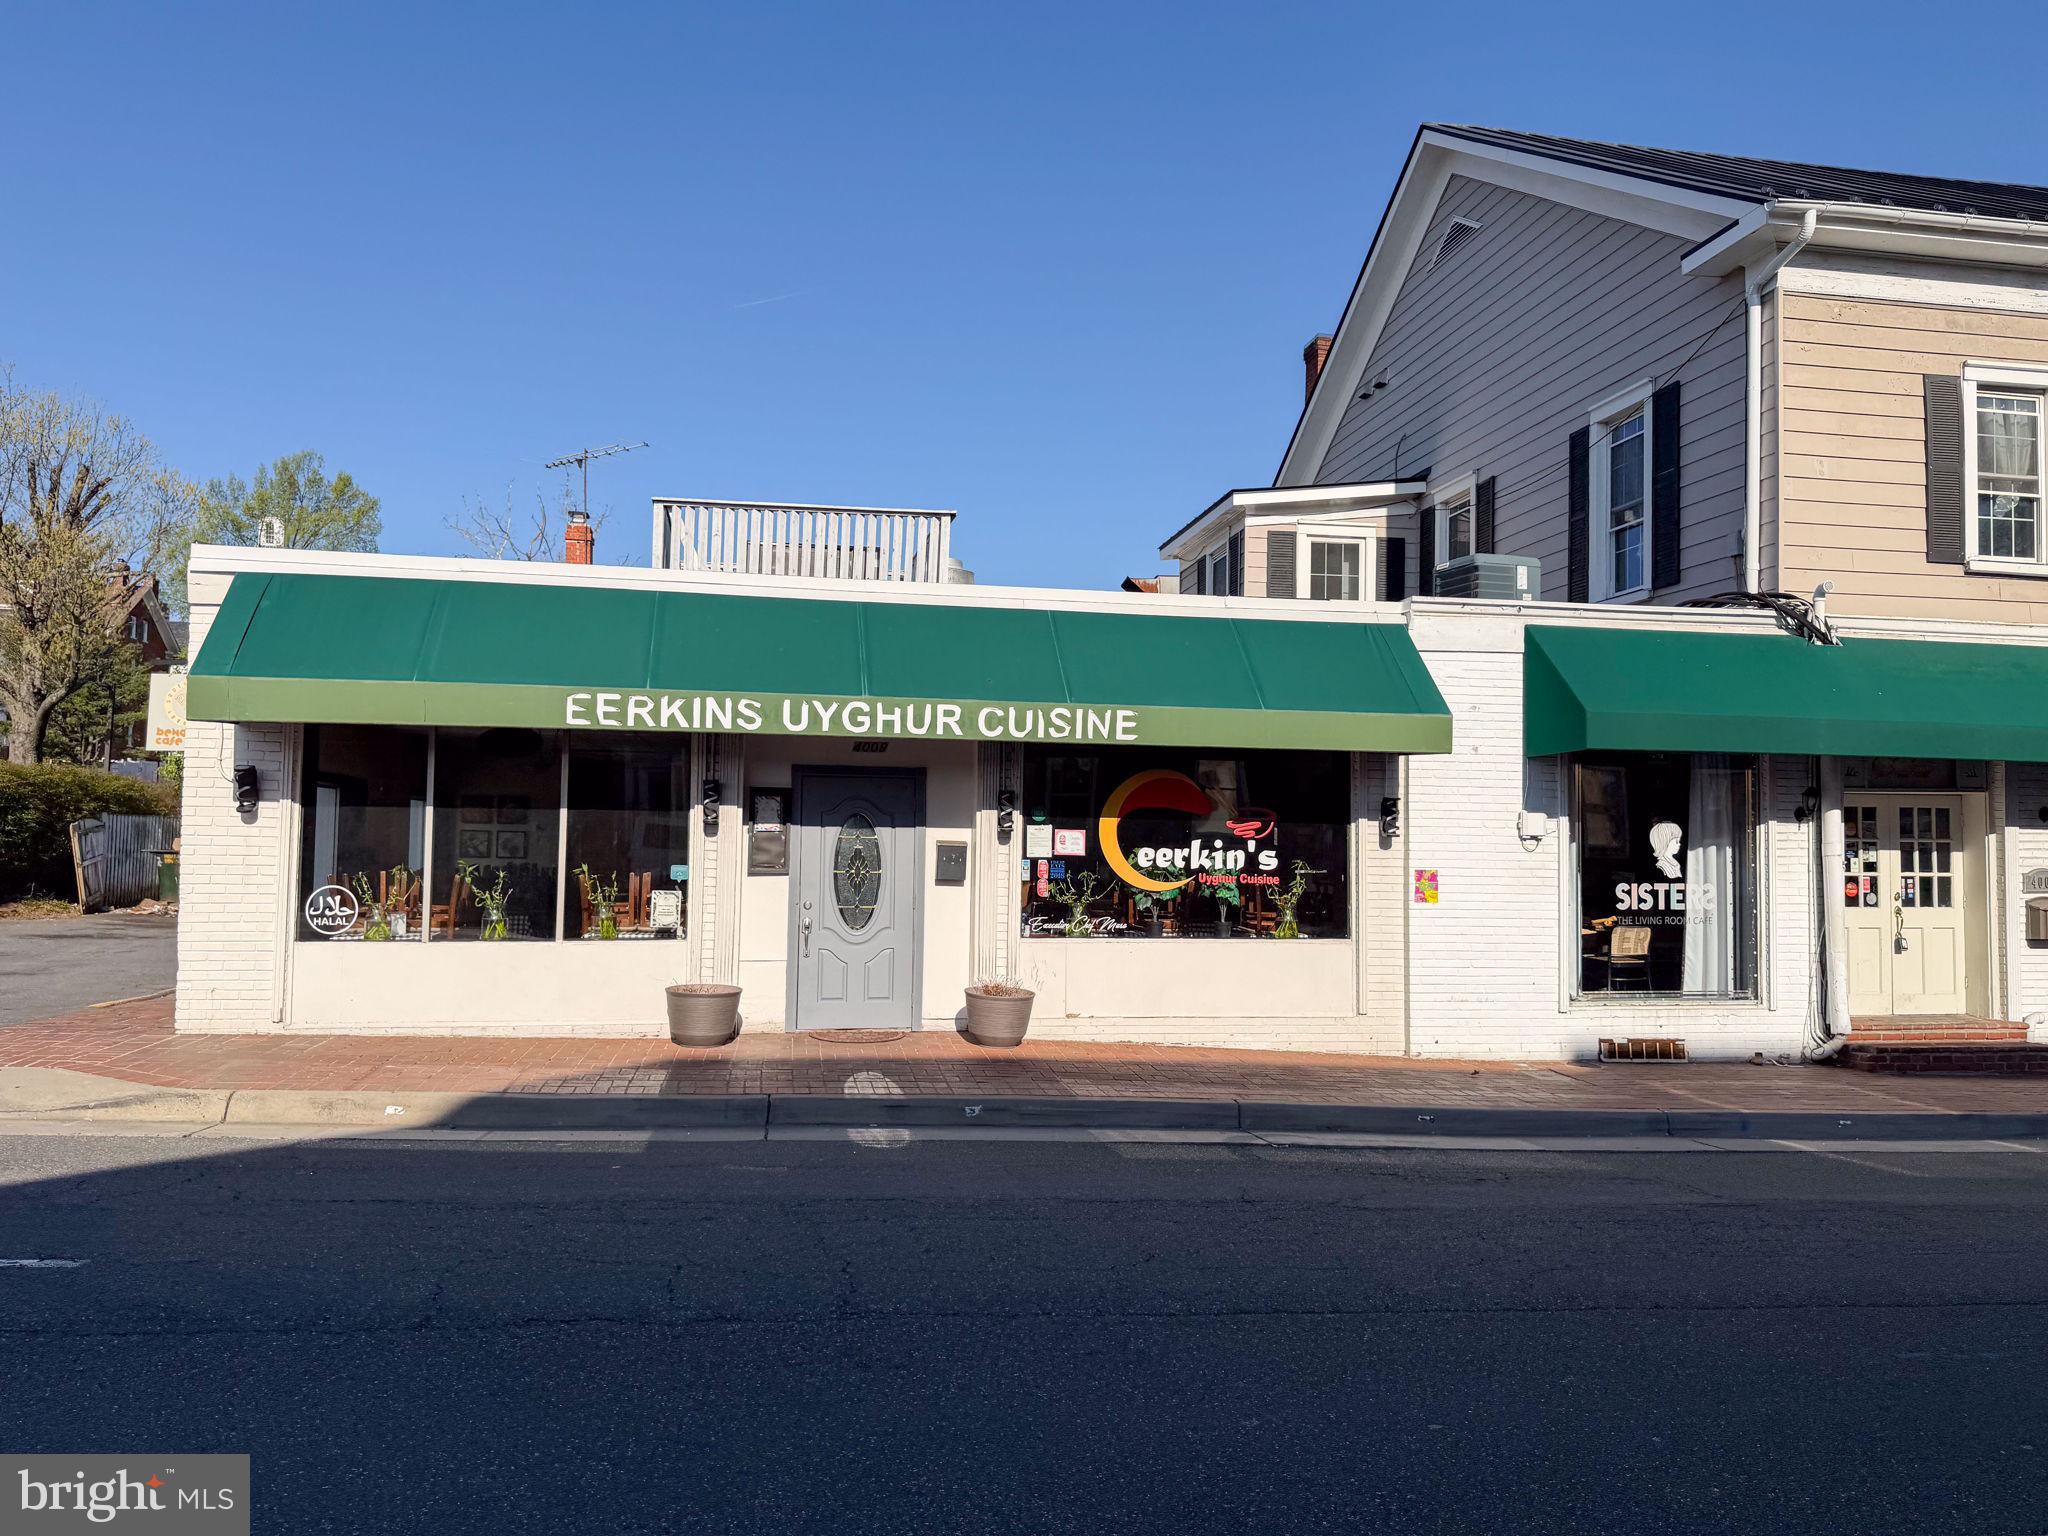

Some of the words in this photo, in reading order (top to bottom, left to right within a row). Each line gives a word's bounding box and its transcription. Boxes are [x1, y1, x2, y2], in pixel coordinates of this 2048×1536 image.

[566, 693, 762, 731] EERKINS
[783, 699, 963, 736] UYGHUR
[978, 706, 1139, 741] CUISINE
[1239, 873, 1280, 885] Cuisine
[1615, 882, 1716, 910] SISTERS
[309, 895, 355, 916] حلال
[313, 916, 349, 926] HALAL
[1617, 916, 1633, 925] THE
[1635, 916, 1662, 925] LIVING
[1664, 916, 1691, 925] ROOM
